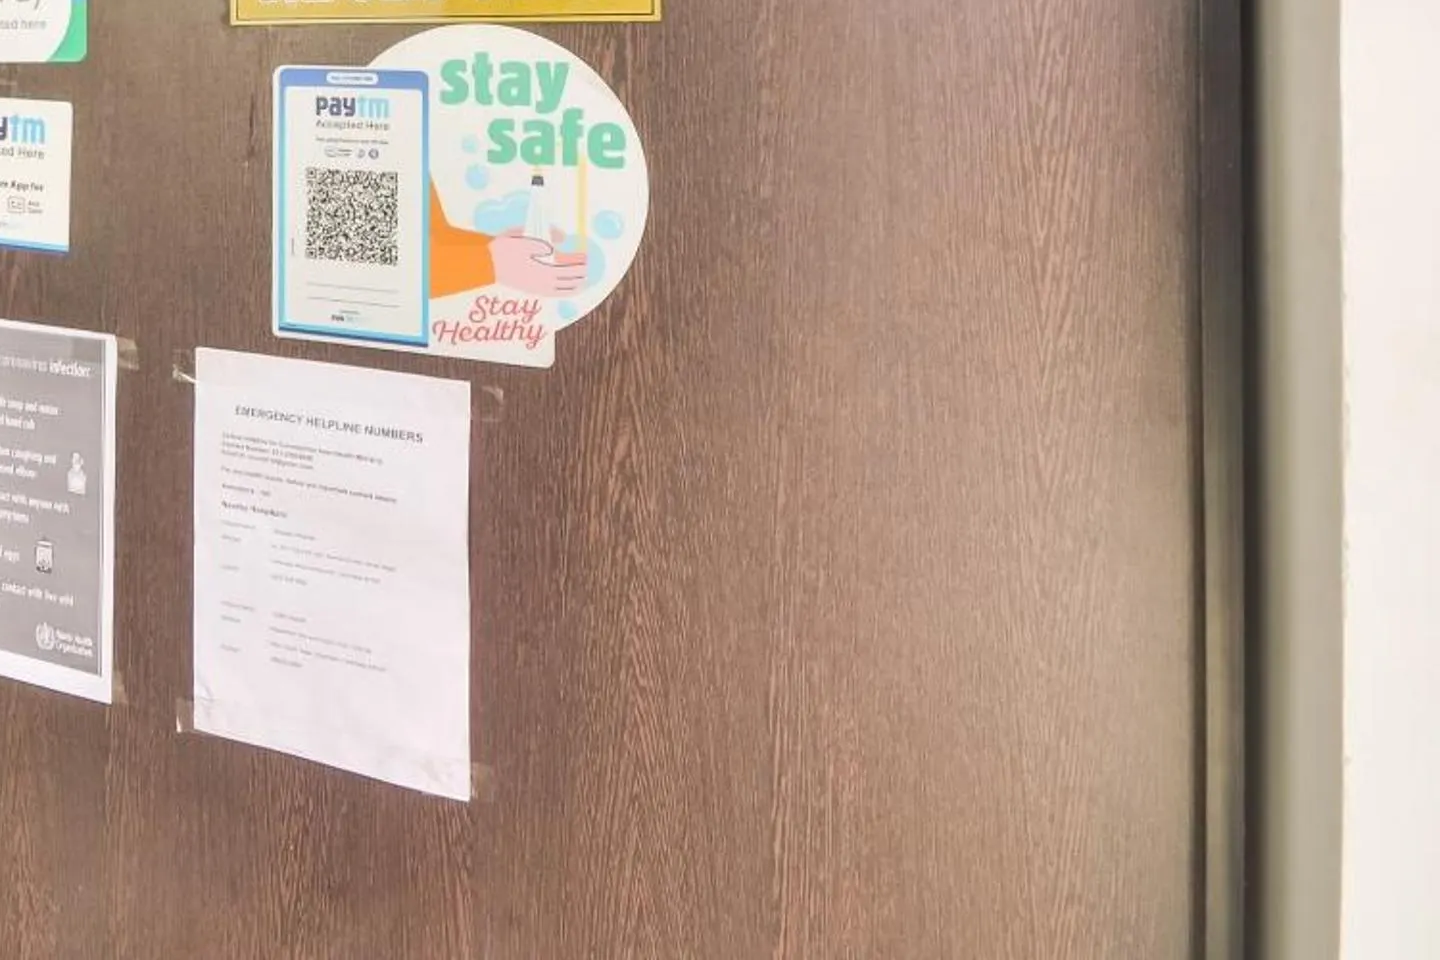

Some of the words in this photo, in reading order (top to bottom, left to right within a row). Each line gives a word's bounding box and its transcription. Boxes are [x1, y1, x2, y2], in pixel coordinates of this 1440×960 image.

[21, 19, 47, 30] here
[439, 51, 570, 114] stay
[316, 119, 363, 131] Accepted
[487, 108, 626, 169] safe
[17, 149, 45, 159] Here
[468, 295, 542, 324] Stay
[432, 319, 547, 350] Healthy
[235, 405, 304, 425] EMERGENCY
[306, 415, 363, 434] HELPLINE
[364, 424, 424, 444] NUMBERS
